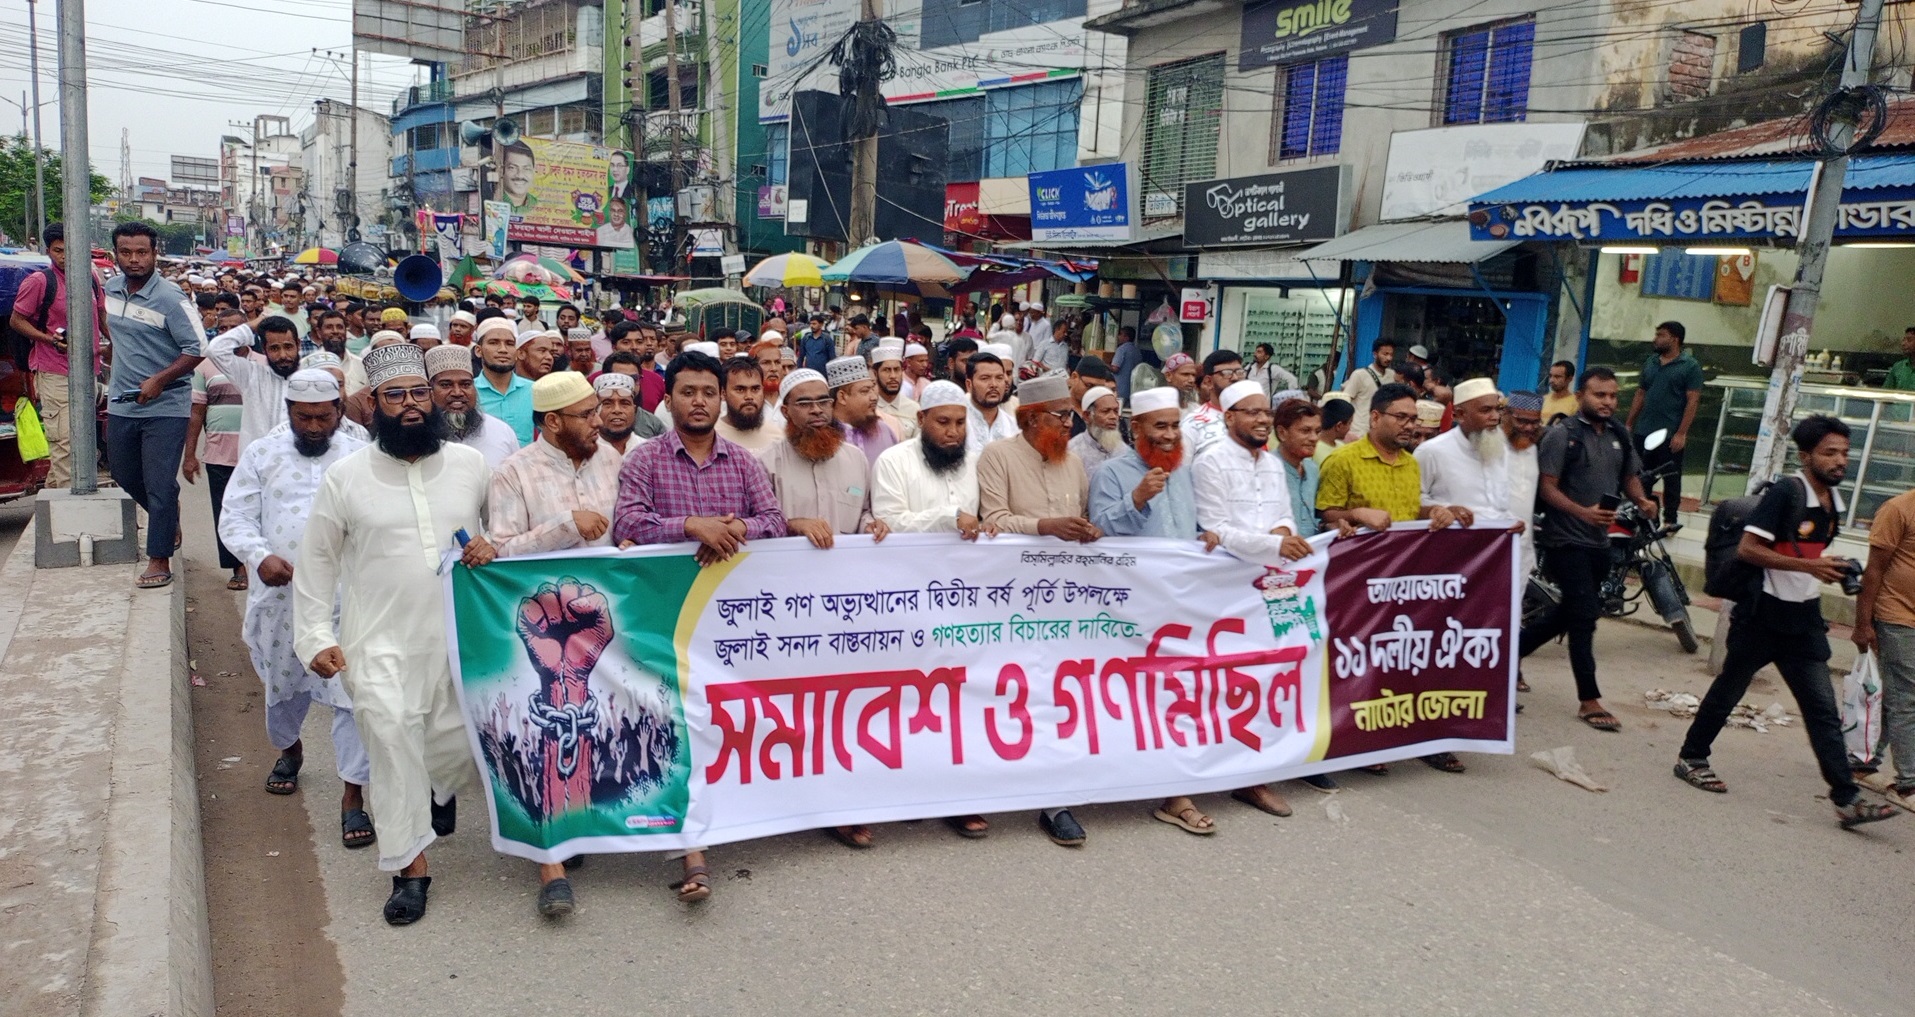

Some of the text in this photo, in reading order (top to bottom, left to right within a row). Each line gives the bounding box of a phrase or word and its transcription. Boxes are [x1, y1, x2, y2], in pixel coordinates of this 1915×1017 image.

[1275, 0, 1352, 38] smile
[934, 58, 959, 73] Bank
[1243, 212, 1310, 232] gallery
[1625, 203, 1675, 237] দধি
[1675, 209, 1699, 234] ও
[1699, 200, 1802, 238] মিষ্টান্ন
[716, 578, 1132, 628] জুলাই গণ অভ্যুত্থানের দ্বিতীয় বর্ষ পূর্তি উপলক্ষে
[1366, 573, 1468, 605] আয়োজনে:
[714, 612, 1143, 668] জুলাই সনদ বাস্তবায়ন ও গণহত্যার বিচারের দাবিতে-
[1333, 614, 1502, 680] ১১ দলীয় ঐক্য
[705, 617, 1309, 786] সমাবেশ ও গণমিছিল
[1350, 688, 1488, 732] নাটোর জেলা
